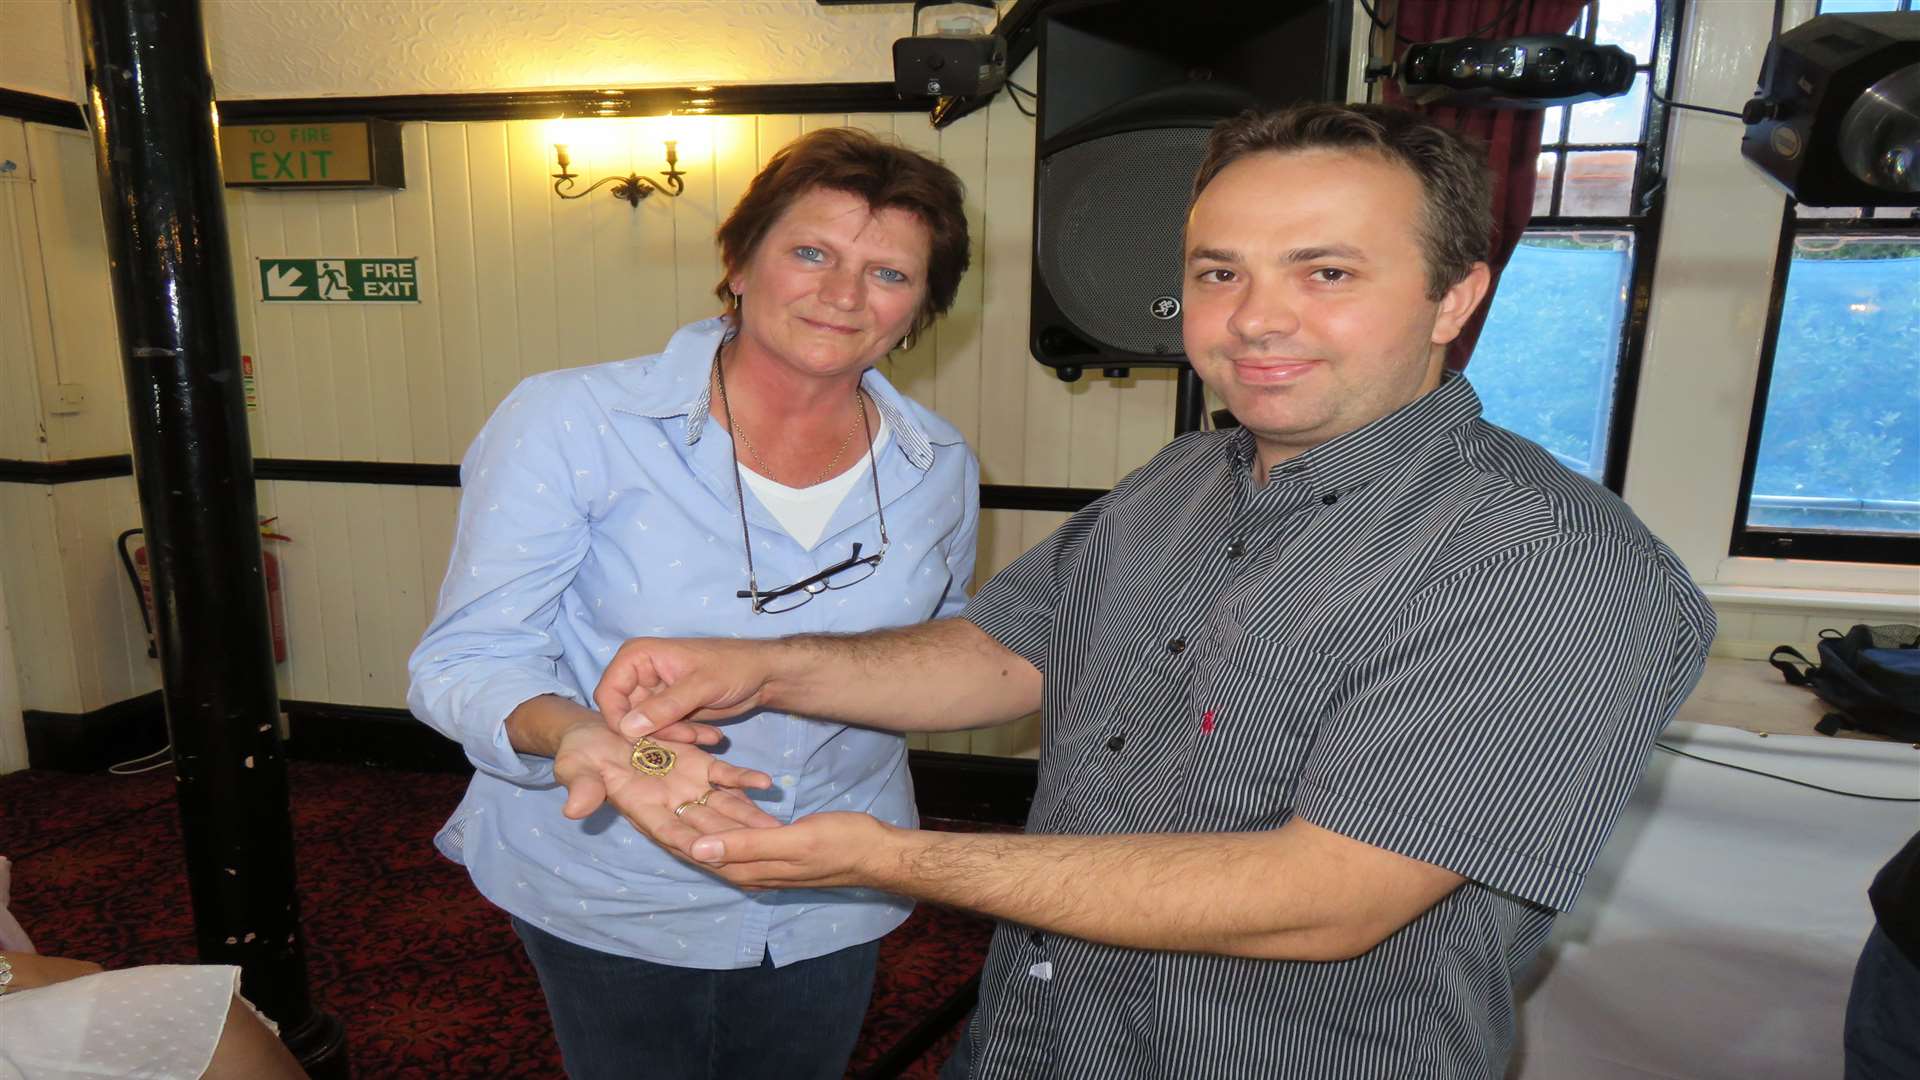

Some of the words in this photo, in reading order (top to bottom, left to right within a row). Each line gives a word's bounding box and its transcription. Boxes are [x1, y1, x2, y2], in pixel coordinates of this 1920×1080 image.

[248, 128, 276, 144] TO
[289, 127, 332, 144] FIRE
[250, 151, 336, 180] EXIT
[361, 263, 414, 278] FIRE
[363, 281, 415, 297] EXIT
